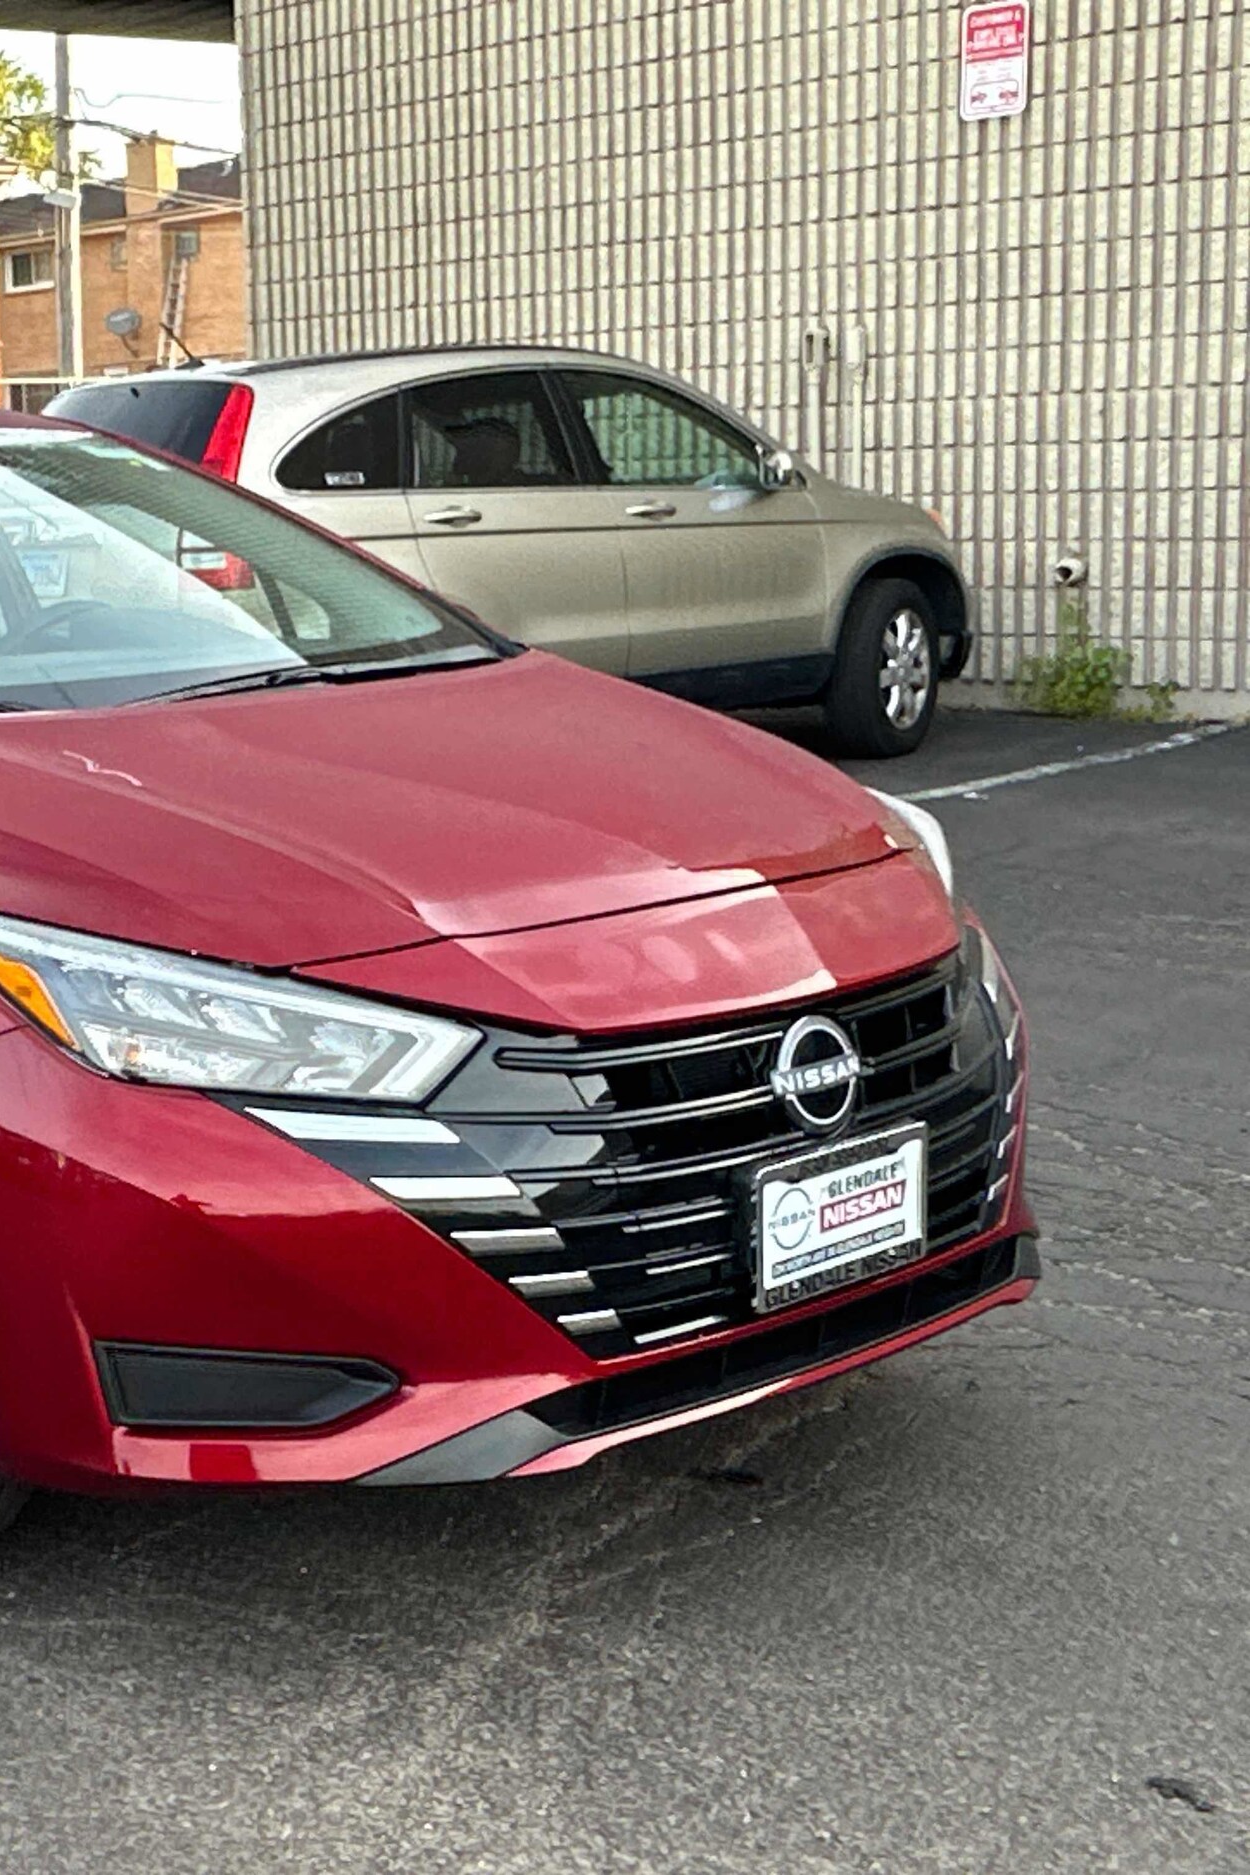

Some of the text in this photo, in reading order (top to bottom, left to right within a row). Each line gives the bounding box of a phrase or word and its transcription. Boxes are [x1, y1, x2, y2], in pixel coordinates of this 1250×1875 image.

[772, 1056, 860, 1094] NISSAN
[826, 1162, 898, 1198] GLENDALE
[768, 1208, 816, 1231] NISSAN
[823, 1185, 903, 1229] NISSAN
